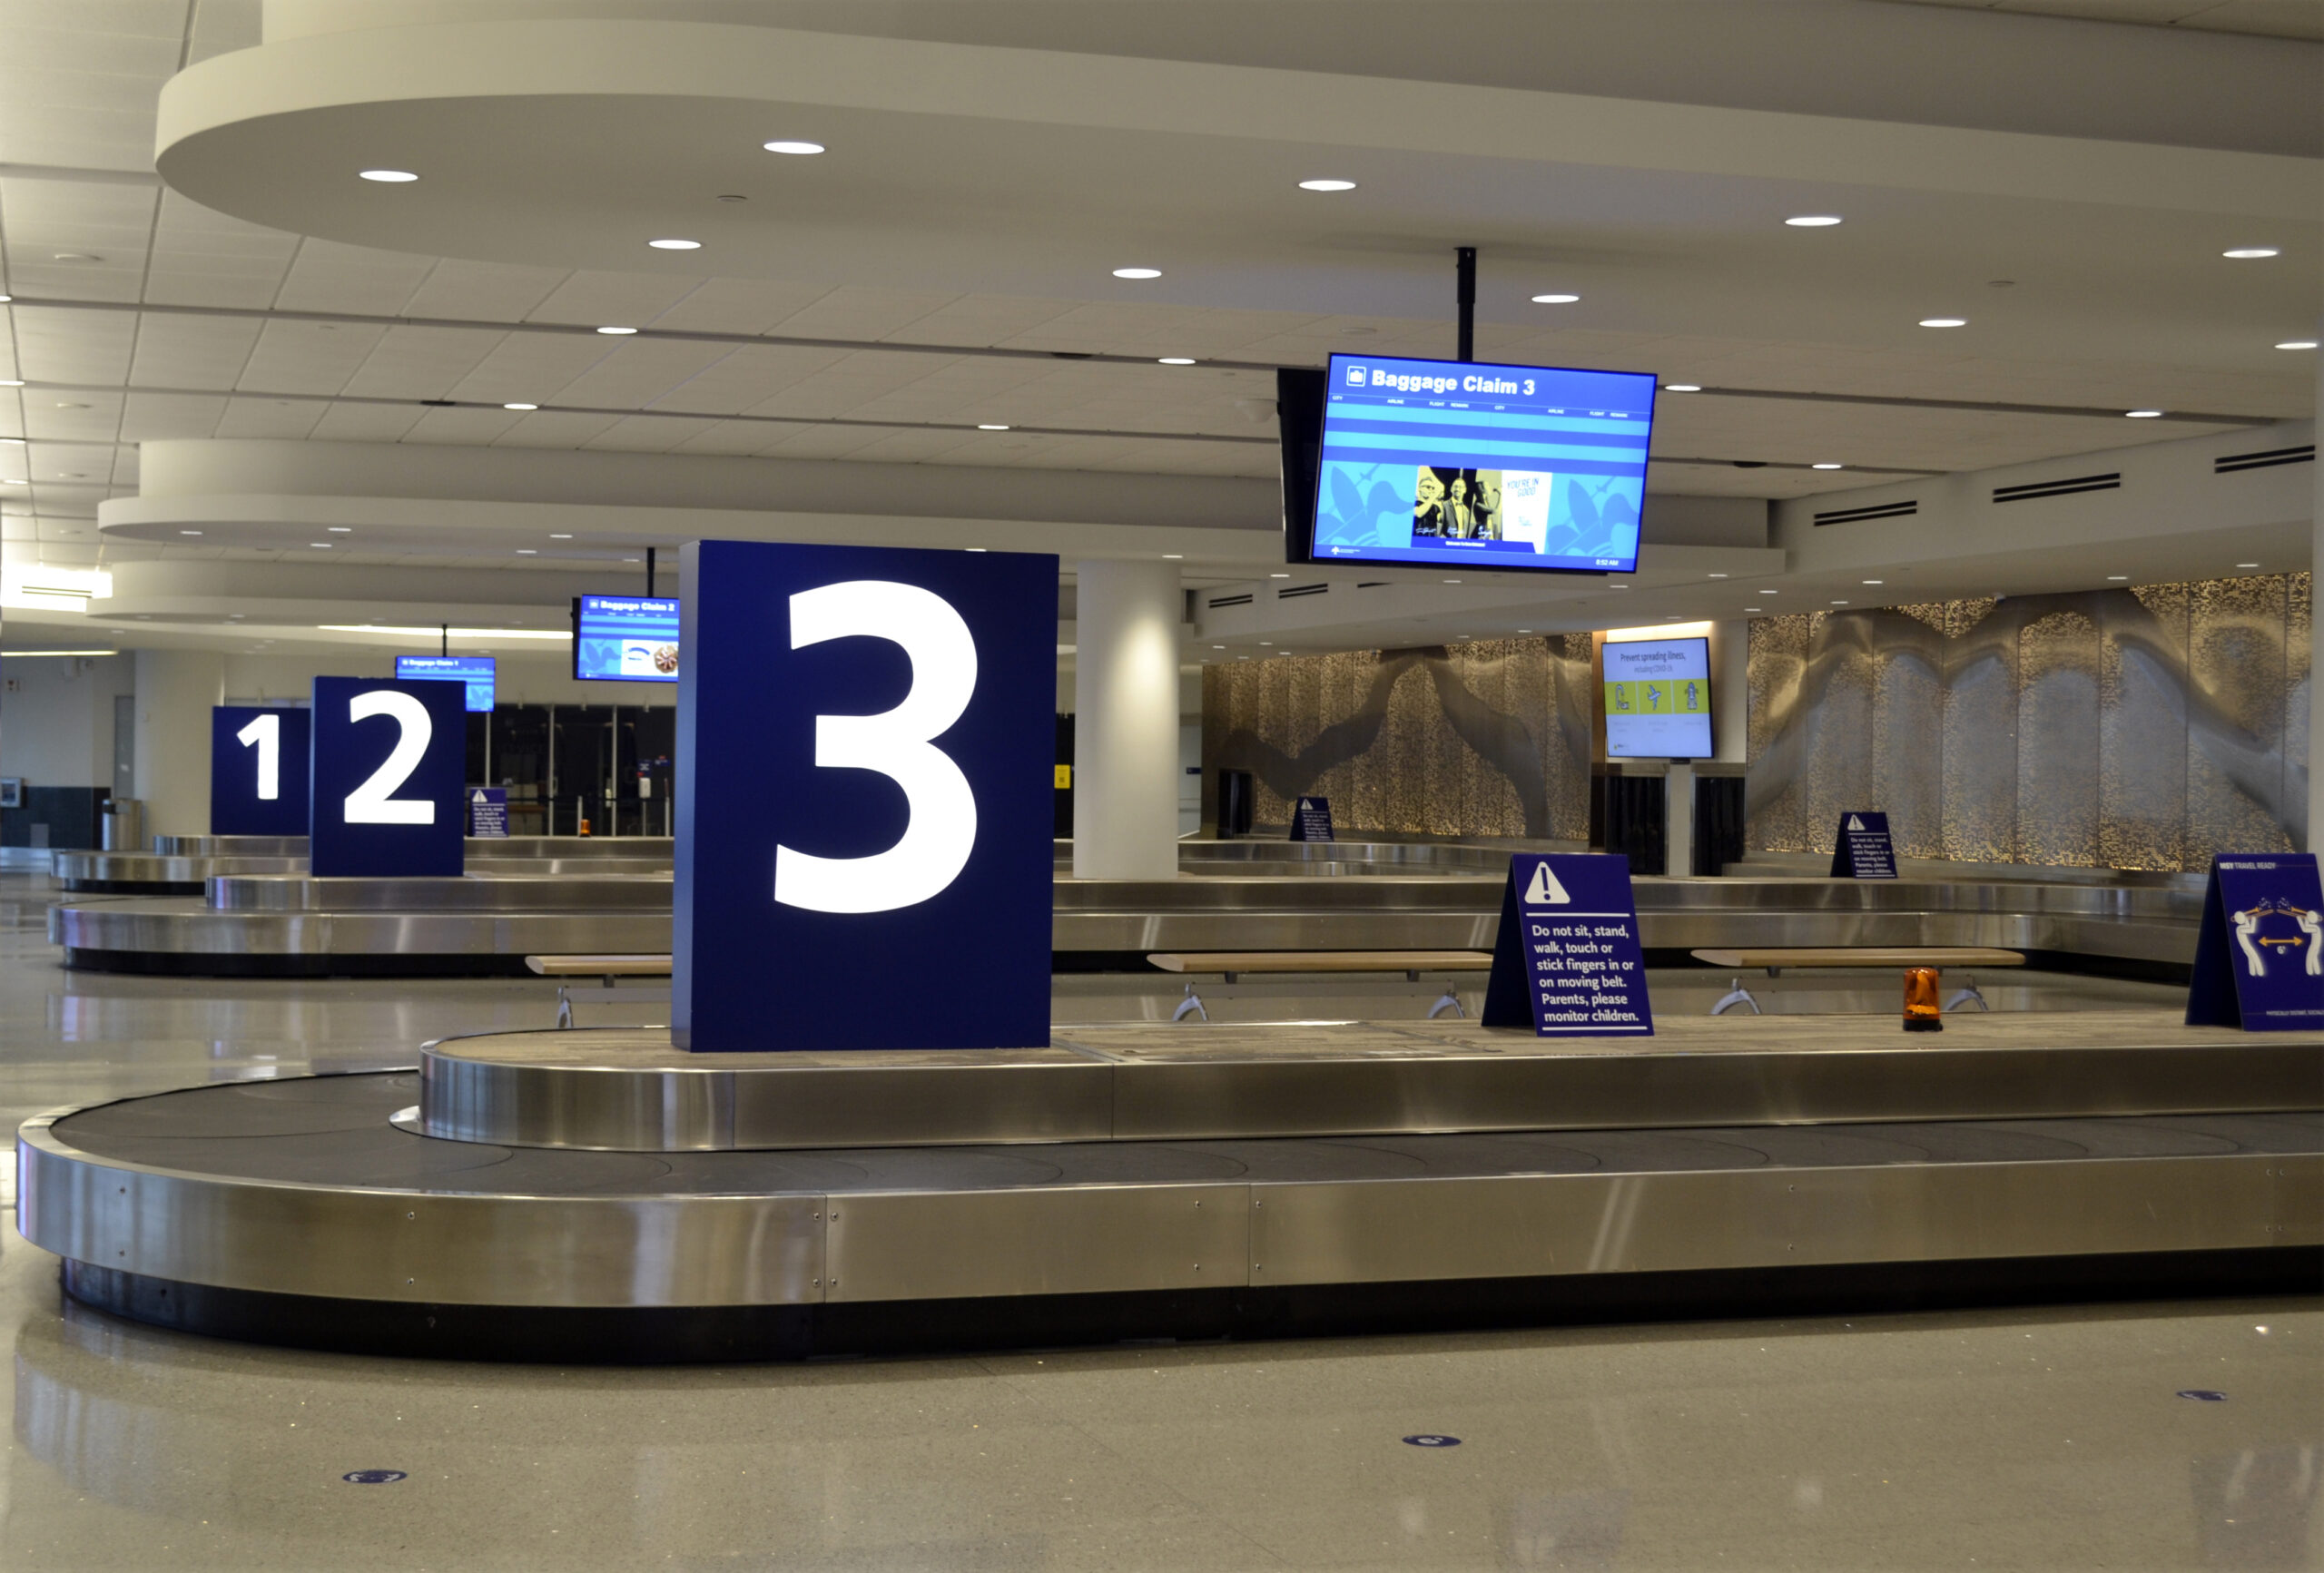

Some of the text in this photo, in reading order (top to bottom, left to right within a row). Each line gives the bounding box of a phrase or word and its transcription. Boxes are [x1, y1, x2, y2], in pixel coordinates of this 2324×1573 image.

[1372, 369, 1535, 395] Baggage Claim 3
[1507, 479, 1529, 488] YOU'RE
[601, 601, 639, 611] Baggage
[641, 603, 666, 611] Claim
[1641, 652, 1667, 662] spreading
[774, 580, 977, 913] 3
[237, 714, 279, 800] 1
[344, 691, 434, 824] 2
[1532, 925, 1630, 939] Do not sit, stand,
[1534, 942, 1612, 955] walk, touch or
[1537, 959, 1634, 973] stick fingers in or
[1540, 976, 1627, 990] on moving belt.
[1541, 993, 1628, 1007] Parents, please
[1545, 1010, 1639, 1022] monitor children.
